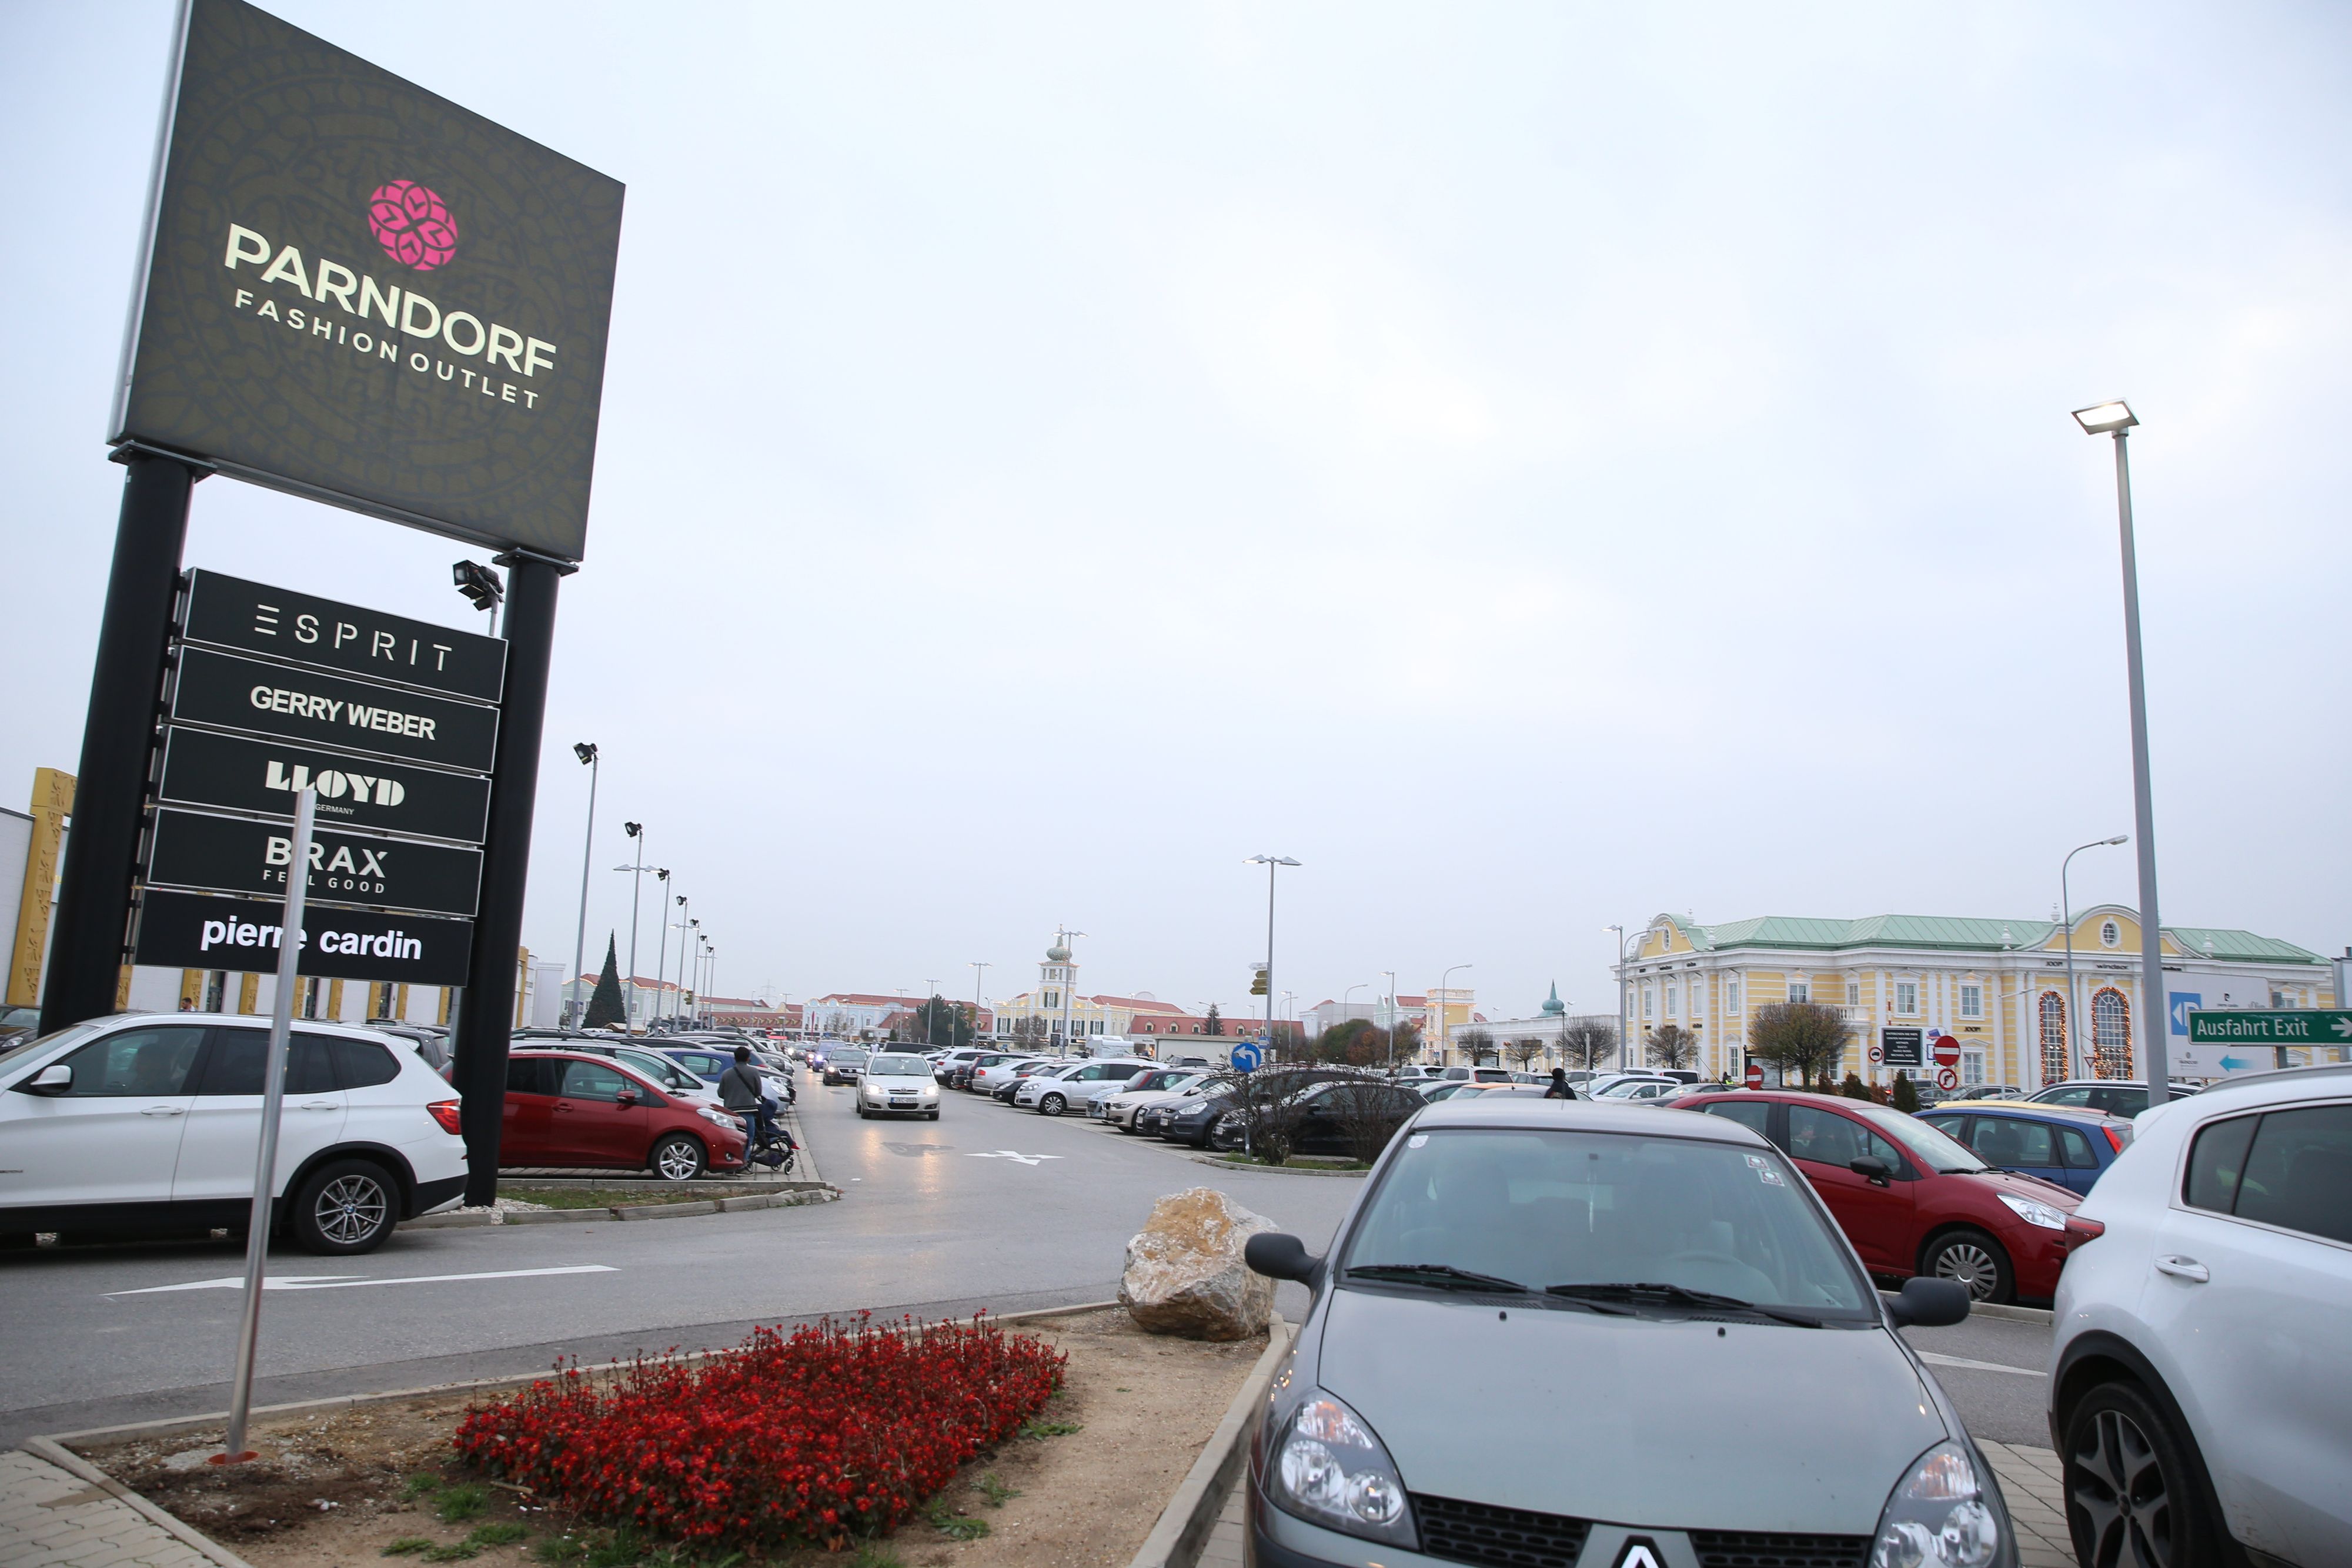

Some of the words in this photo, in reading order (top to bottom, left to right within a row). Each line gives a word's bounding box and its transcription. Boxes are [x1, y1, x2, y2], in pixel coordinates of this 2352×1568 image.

[225, 223, 557, 377] PARNDORF
[235, 289, 397, 363] FASHION
[410, 353, 539, 409] OUTLET
[255, 604, 452, 671] ESPRIT
[250, 686, 344, 722] GERRY
[348, 703, 436, 741] WEBER
[265, 760, 405, 806] LLOYD
[315, 803, 355, 815] GERMANY
[265, 836, 388, 878] BRAX
[263, 870, 316, 886] FEL
[328, 877, 385, 894] GOOD
[320, 930, 422, 959] cardin
[2197, 1018, 2269, 1036] Ausfahrt
[2274, 1018, 2310, 1036] Exit
